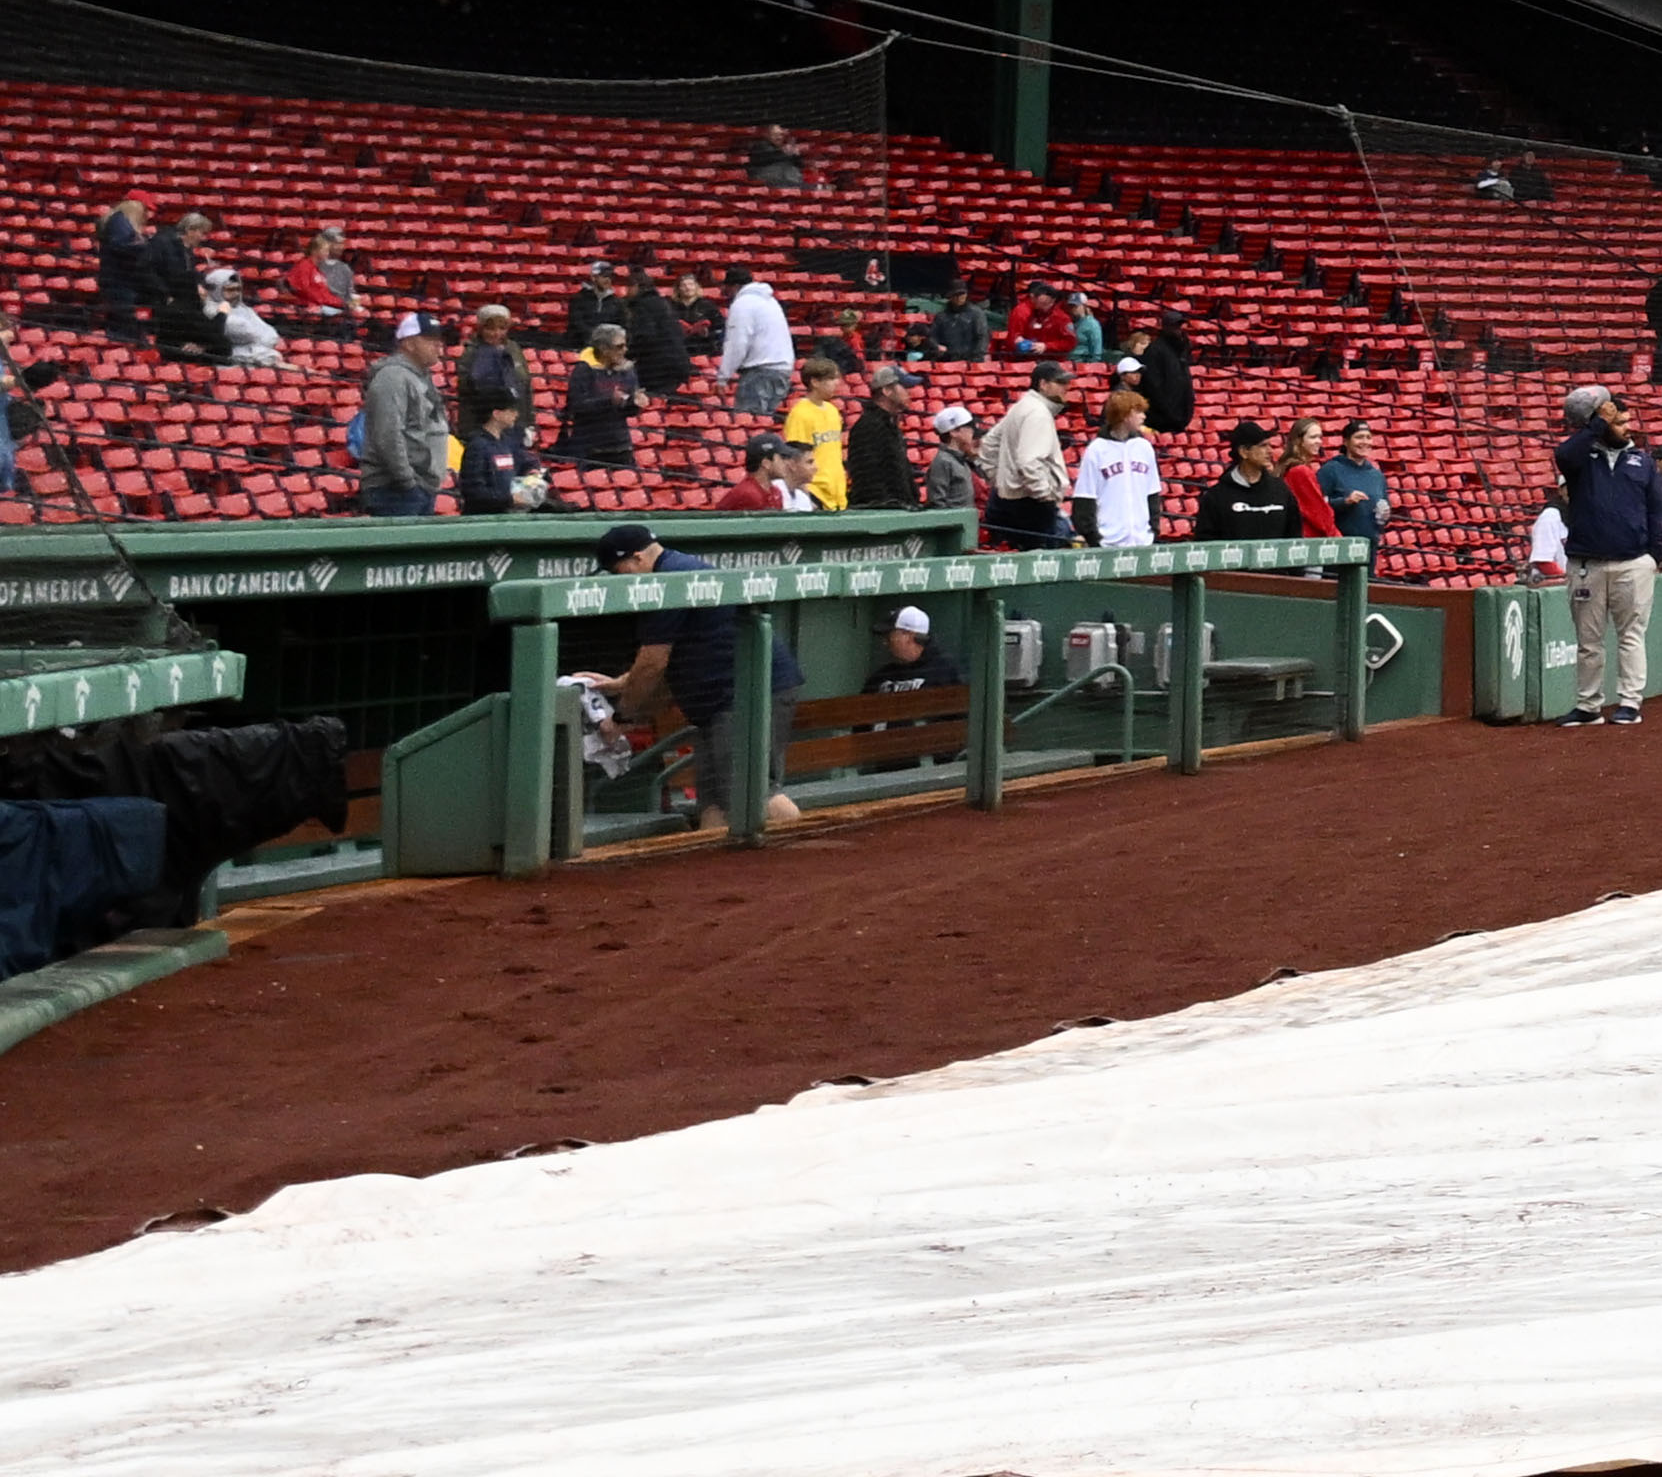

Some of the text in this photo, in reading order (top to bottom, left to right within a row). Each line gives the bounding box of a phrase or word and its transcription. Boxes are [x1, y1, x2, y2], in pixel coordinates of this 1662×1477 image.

[366, 561, 486, 587] BANK OF AMERICA
[537, 558, 571, 577] BANK
[572, 557, 588, 575] OF
[734, 551, 781, 568] AMERICA
[22, 580, 99, 603] AMERICA
[170, 570, 306, 598] BANK OF AMERICA
[628, 577, 666, 609] xfinity
[687, 574, 724, 606] xfinity
[742, 571, 778, 602] xfinity
[796, 567, 831, 597] xfinity
[850, 564, 883, 595] xfinity
[567, 581, 608, 615] xfinity
